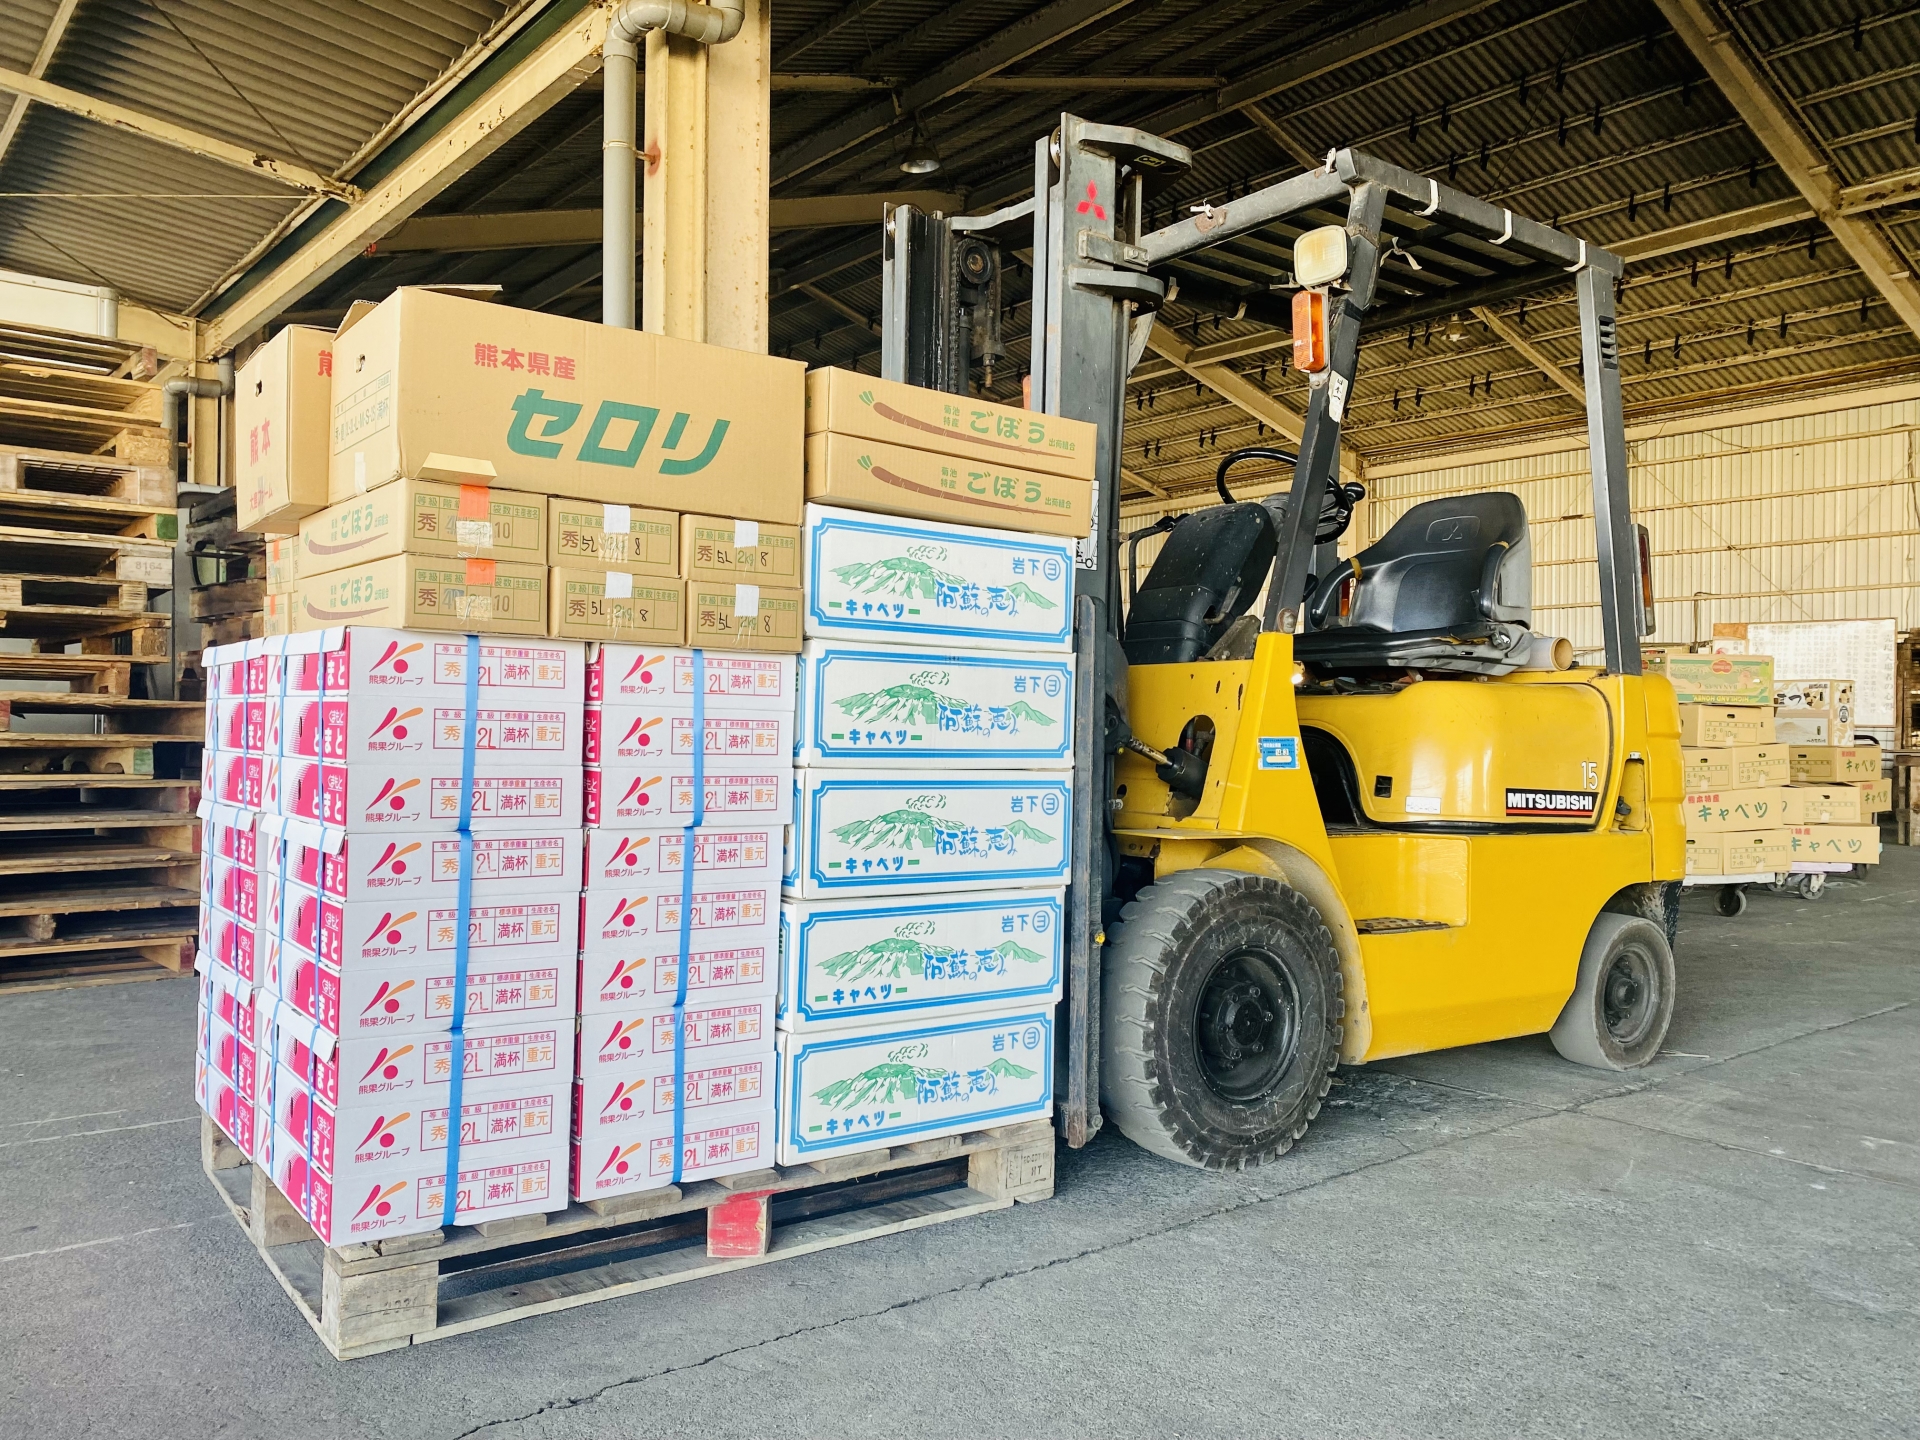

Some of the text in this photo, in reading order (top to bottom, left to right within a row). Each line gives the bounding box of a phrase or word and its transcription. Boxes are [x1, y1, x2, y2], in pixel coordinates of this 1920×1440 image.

[474, 343, 576, 380] 熊本県産
[944, 405, 960, 416] 菊池
[943, 416, 959, 428] 特産
[970, 411, 1045, 443] ごぼう
[506, 387, 730, 476] セロリ
[250, 418, 270, 467] 熊本
[1049, 438, 1075, 451] 出荷組合
[942, 467, 957, 477] 菊池
[941, 478, 956, 489] 特産
[968, 472, 1041, 502] ごぼう
[418, 496, 437, 506] 等級
[515, 508, 538, 518] 生産者名
[1045, 497, 1072, 509] 出荷組合
[341, 504, 373, 538] ごぼう
[418, 513, 437, 532] 秀
[562, 514, 579, 525] 等級
[562, 531, 579, 548] 秀
[635, 538, 640, 555] 8
[697, 545, 768, 566] 秀 5L 2kg 8
[135, 561, 162, 570] 8164
[418, 571, 437, 582] 等級
[515, 580, 539, 589] 生産者名
[569, 584, 587, 594] 等級
[341, 576, 373, 606] ごぼう
[418, 589, 437, 607] 秀
[934, 579, 1020, 618] 阿蘇の恵み
[569, 600, 586, 617] 秀
[592, 600, 605, 615] 5L
[640, 609, 648, 621] 8
[846, 599, 904, 619] キャベツ
[701, 611, 716, 627] 秀
[719, 612, 732, 630] 5L
[764, 615, 771, 633] 8
[442, 646, 462, 654] 等級
[444, 661, 562, 680] 秀 満杯 重元
[369, 675, 423, 685] 熊果グループ
[709, 674, 752, 692] 2L 満杯
[620, 686, 665, 694] 熊果グループ
[442, 711, 462, 719] 等級
[937, 703, 1020, 737] 阿蘇の恵み
[314, 727, 342, 755] とまと
[443, 725, 530, 749] 秀 2L 満杯
[706, 732, 776, 750] 2L 満杯 重元
[849, 729, 907, 745] キャベツ
[368, 742, 423, 751] 熊果グループ
[618, 748, 663, 756] 熊果グループ
[1846, 759, 1876, 772] キャベツ
[1581, 761, 1598, 790] 15
[312, 789, 341, 821] とまと
[441, 791, 559, 811] 秀 2L 満杯 重元
[705, 791, 749, 810] 2L 満杯
[1508, 793, 1592, 810] MITSUBISHI
[365, 813, 420, 822] 熊果グループ
[617, 808, 662, 816] 熊果グループ
[1698, 802, 1768, 822] キャベツ
[935, 826, 1018, 859] 阿蘇の恵み
[1792, 837, 1862, 853] キャベツ
[442, 852, 528, 874] 秀 2L 満杯
[717, 847, 765, 863] 満杯 重元
[605, 867, 650, 878] 熊果グループ
[845, 856, 904, 874] キャベツ
[367, 876, 422, 888] 熊果グループ
[714, 906, 736, 921] 満杯
[498, 920, 556, 938] 満杯 重元
[602, 928, 648, 939] 熊果グループ
[362, 946, 417, 958] 熊果グループ
[924, 947, 1008, 981] 阿蘇の恵み
[689, 962, 761, 985] 2L 満杯 重元
[469, 988, 522, 1013] 2L 満杯
[600, 989, 646, 1001] 熊果グループ
[833, 983, 892, 1005] キャベツ
[360, 1014, 415, 1027] 熊果グループ
[685, 1023, 732, 1042] 2L 満杯
[463, 1046, 552, 1073] 2L 満杯 重元
[599, 1049, 644, 1063] 熊果グループ
[359, 1080, 414, 1094] 熊果グループ
[686, 1077, 759, 1101] 2L 満杯 重元
[916, 1068, 999, 1104] 阿蘇の恵み
[600, 1110, 645, 1125] 熊果グループ
[826, 1111, 885, 1135] キャベツ
[461, 1117, 517, 1144] 2L 満杯
[355, 1147, 410, 1163] 熊果グループ
[684, 1143, 730, 1168] 2L 満杯
[488, 1176, 546, 1200] 満杯 重元
[596, 1173, 641, 1189] 熊果グループ
[351, 1215, 406, 1233] 熊果グループ
